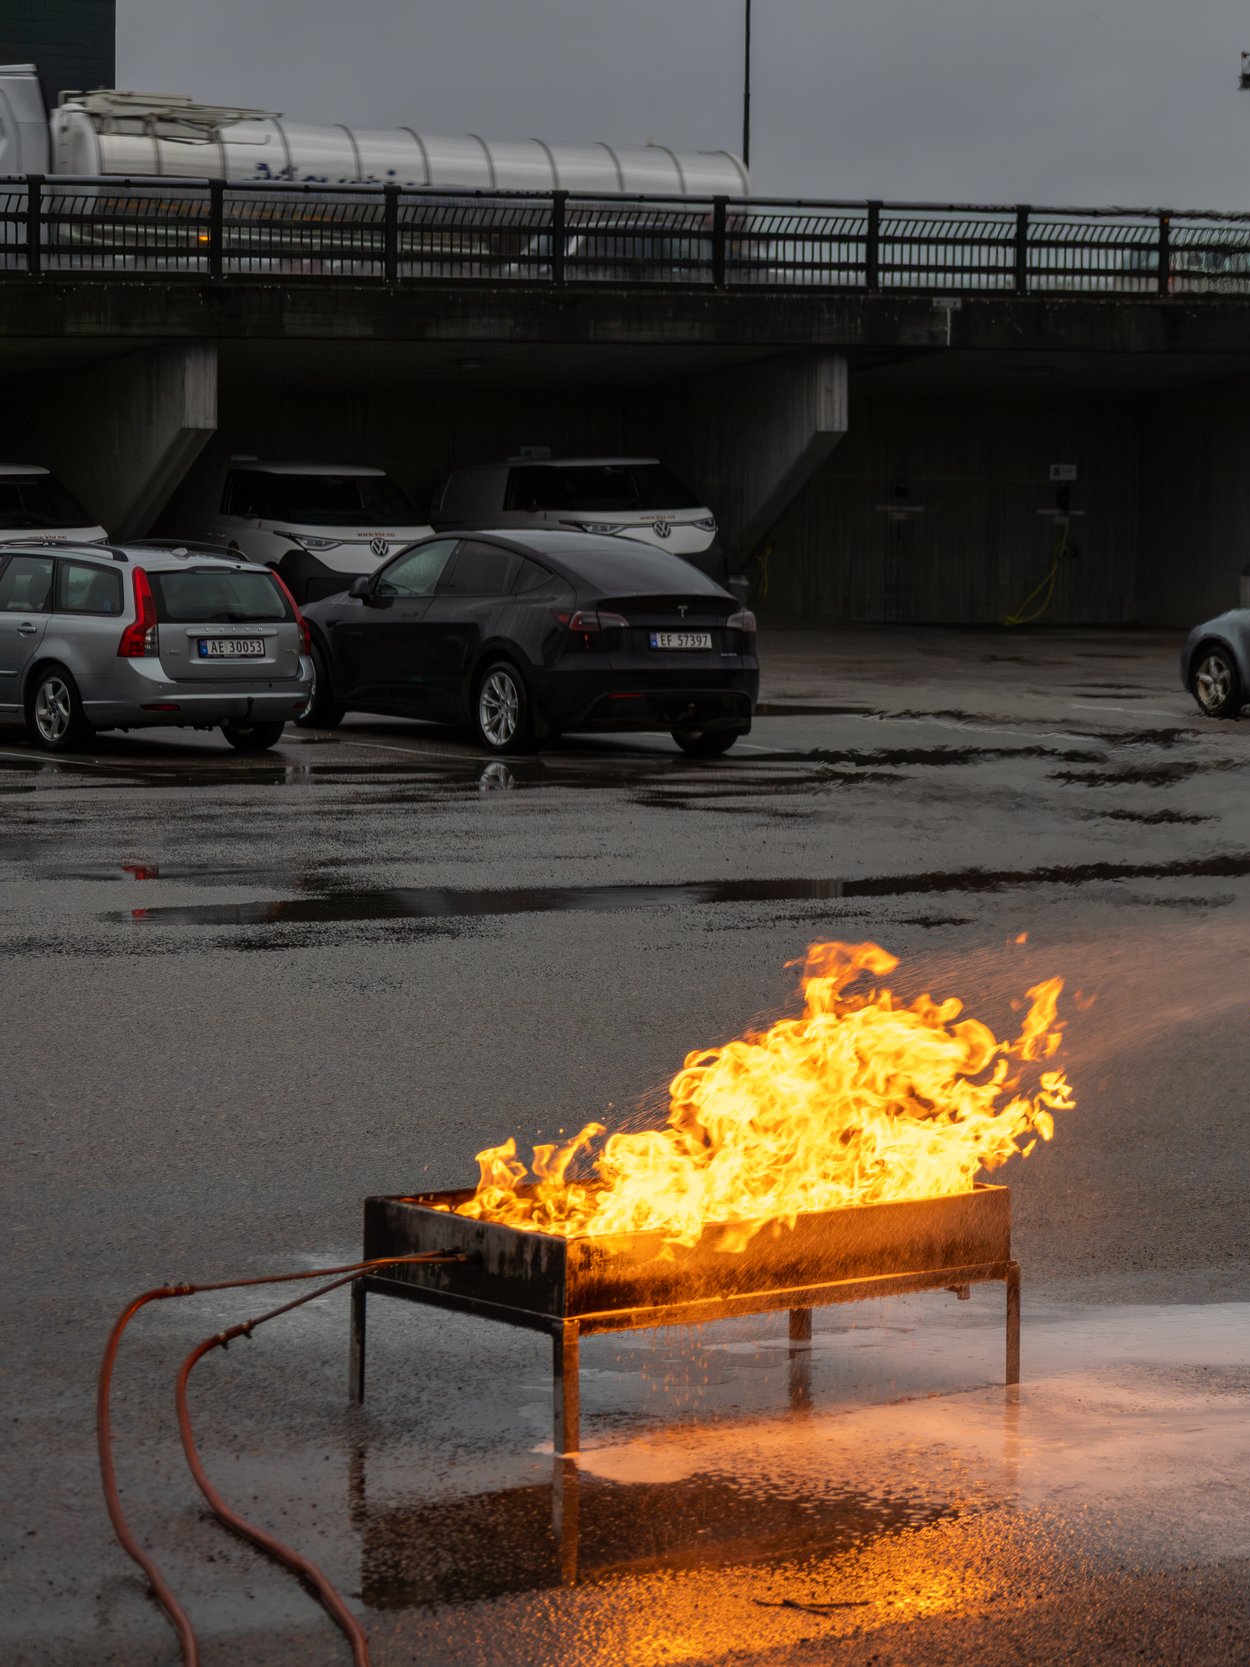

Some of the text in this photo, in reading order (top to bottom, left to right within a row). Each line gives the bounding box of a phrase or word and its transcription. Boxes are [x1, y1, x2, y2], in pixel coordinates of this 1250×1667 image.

[660, 634, 708, 647] EF 57397
[211, 641, 262, 653] AE 30053
